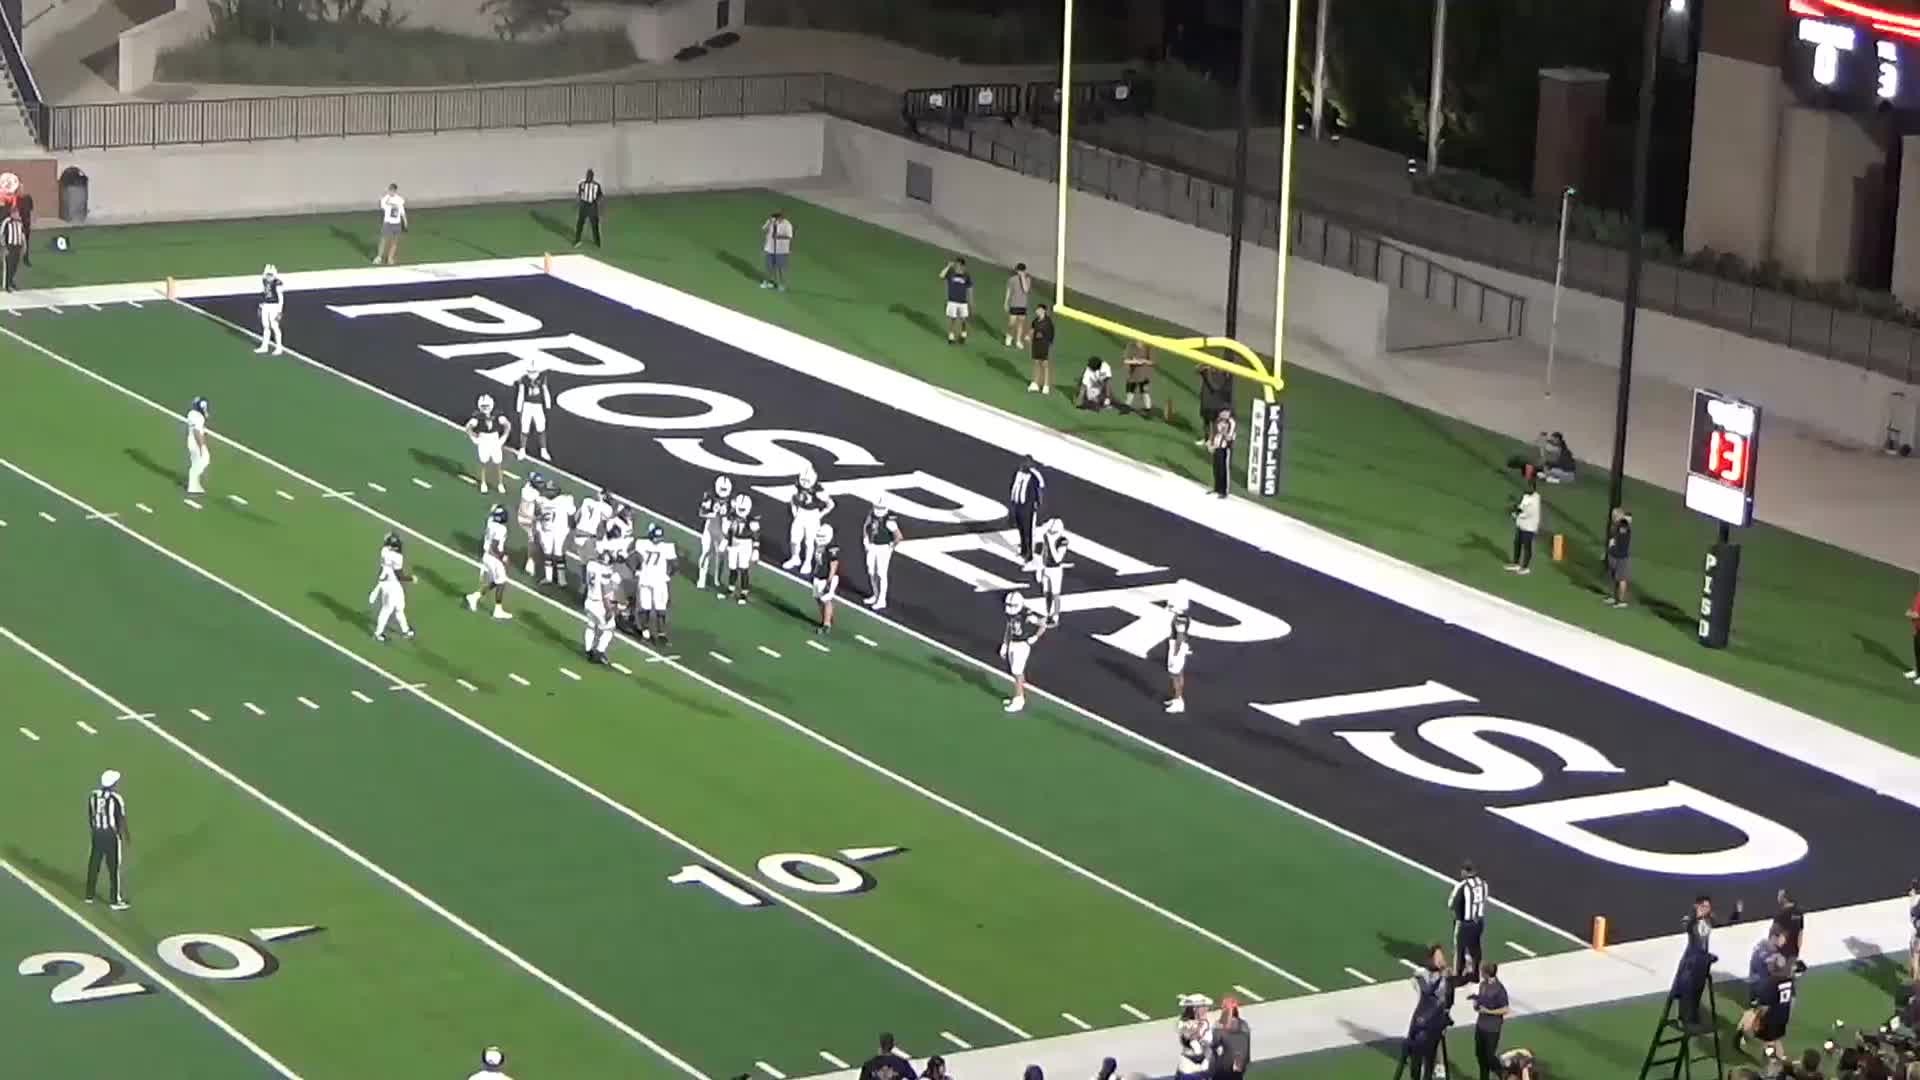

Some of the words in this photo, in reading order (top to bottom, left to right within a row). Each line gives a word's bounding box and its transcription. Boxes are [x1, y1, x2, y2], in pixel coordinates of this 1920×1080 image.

[1264, 405, 1280, 495] EAGLES
[1708, 430, 1743, 481] 13
[325, 294, 1292, 659] PROSPER
[1248, 680, 1809, 876] ISD
[645, 550, 660, 566] 77
[1699, 553, 1718, 637] PISD
[667, 852, 870, 906] 10
[18, 933, 272, 1003] 20
